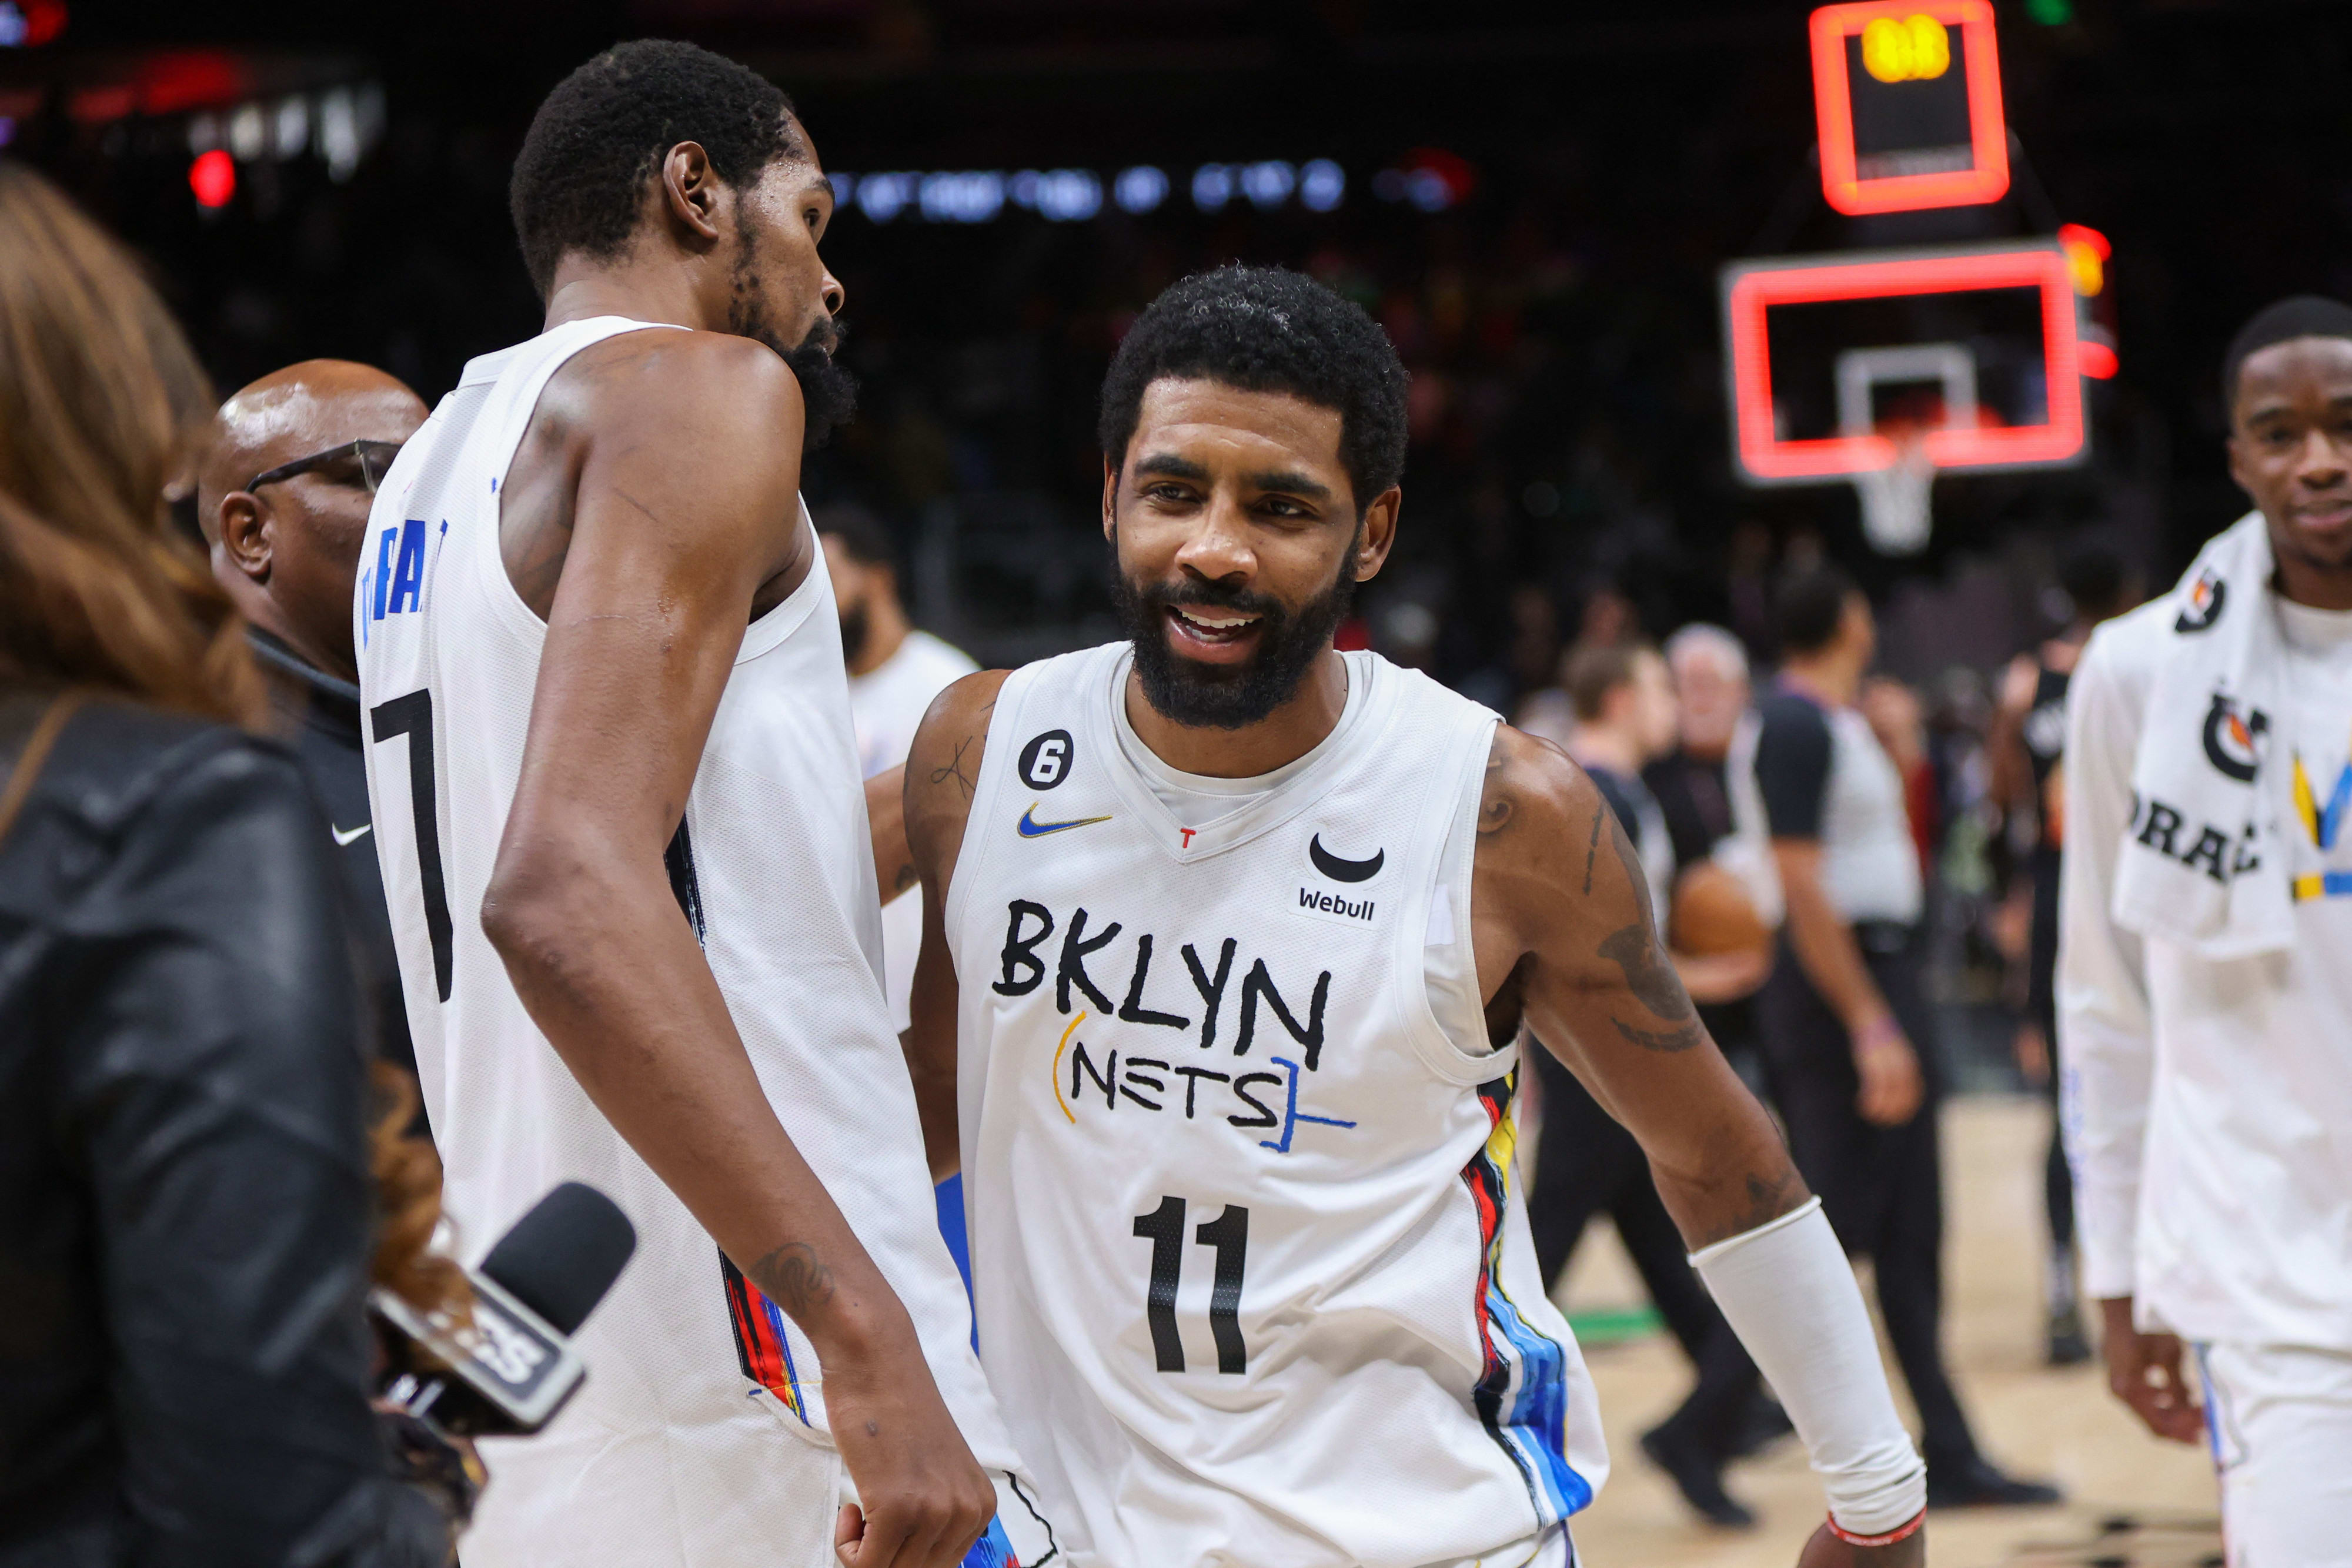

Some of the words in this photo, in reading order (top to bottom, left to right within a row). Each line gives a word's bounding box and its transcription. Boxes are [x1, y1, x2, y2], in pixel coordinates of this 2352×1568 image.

[1029, 738, 1065, 784] 6
[370, 688, 453, 1003] 7
[1180, 827, 1197, 849] T
[1299, 887, 1375, 922] Webull
[991, 899, 1332, 1071] BKLYN
[1071, 1042, 1282, 1127] NETS
[1133, 1195, 1249, 1375] 11
